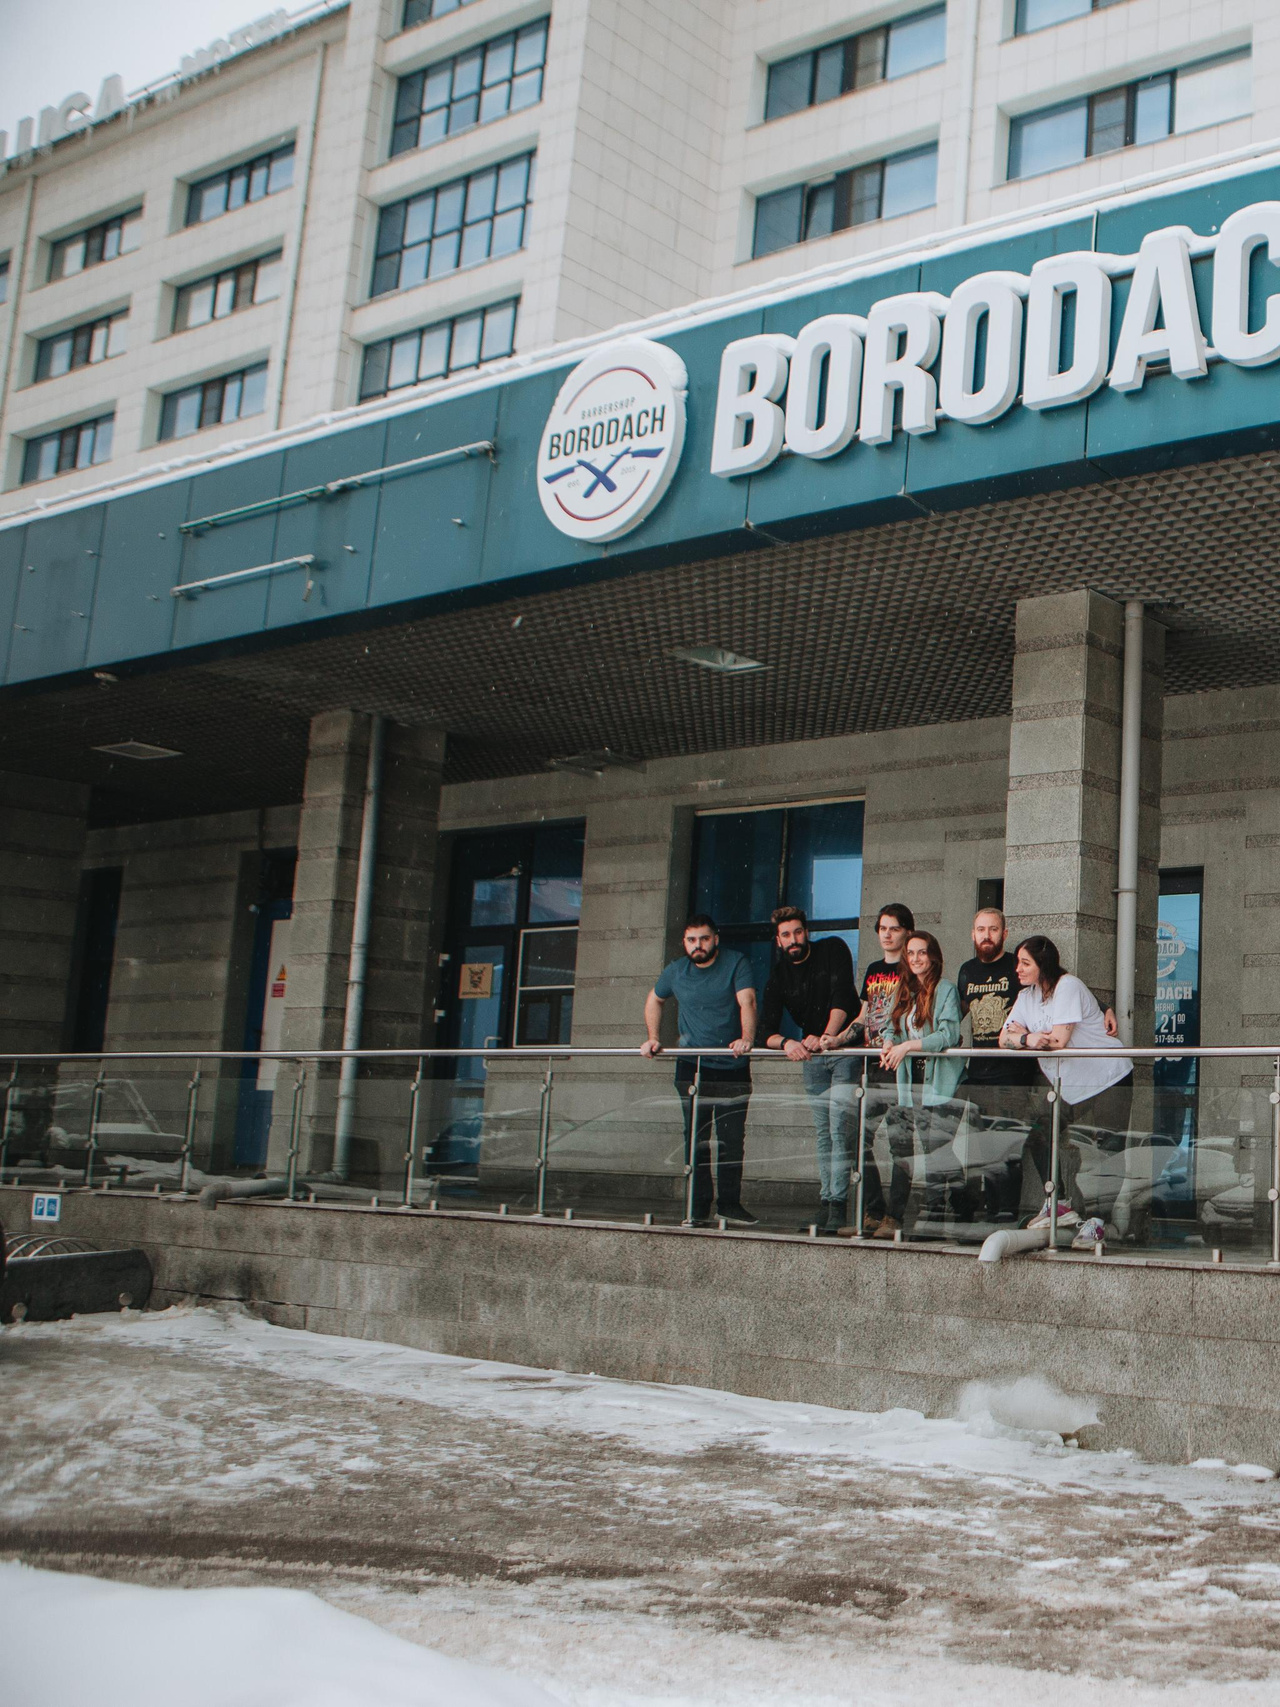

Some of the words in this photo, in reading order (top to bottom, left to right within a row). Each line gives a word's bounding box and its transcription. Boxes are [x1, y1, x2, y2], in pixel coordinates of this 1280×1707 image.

[581, 397, 636, 420] BARBERSHOP
[548, 404, 666, 460] BORODACH
[1157, 943, 1179, 954] DACH
[1156, 986, 1193, 1000] DACH
